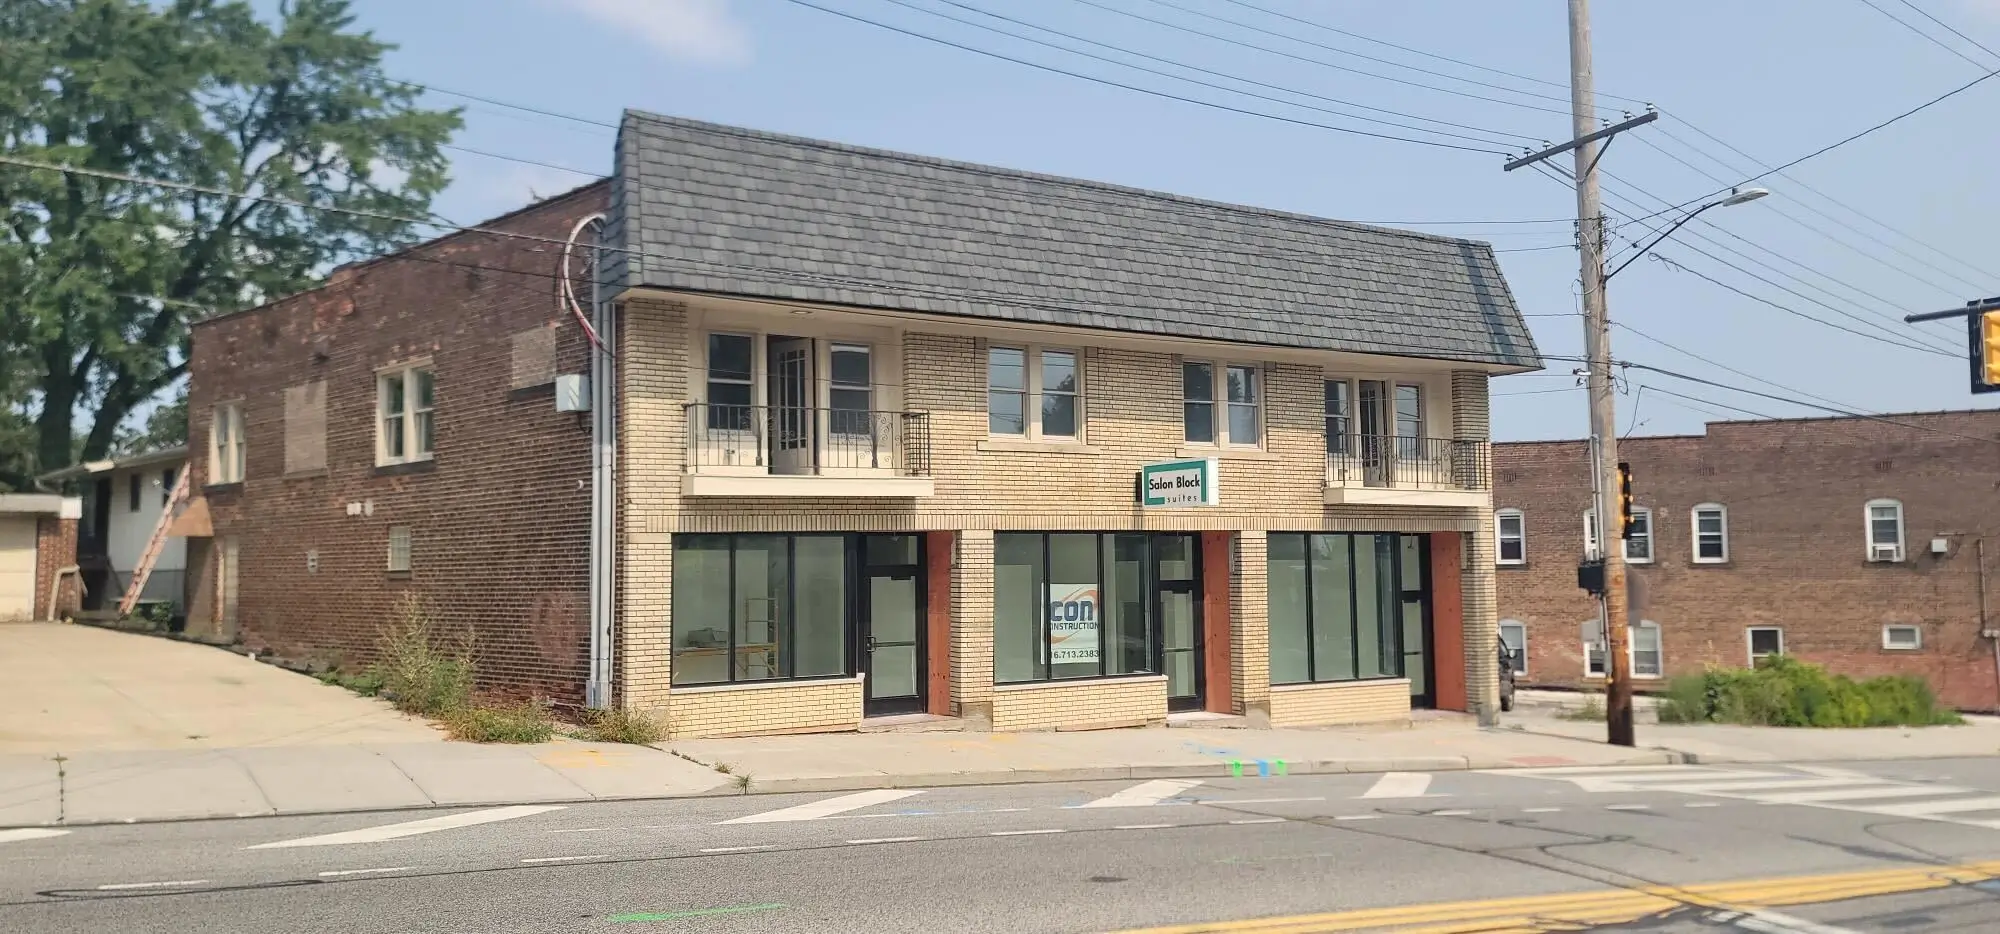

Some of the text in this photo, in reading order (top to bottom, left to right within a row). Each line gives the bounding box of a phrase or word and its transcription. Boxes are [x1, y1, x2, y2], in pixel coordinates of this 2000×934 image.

[1149, 474, 1200, 490] Salon Block
[1167, 494, 1197, 502] suites
